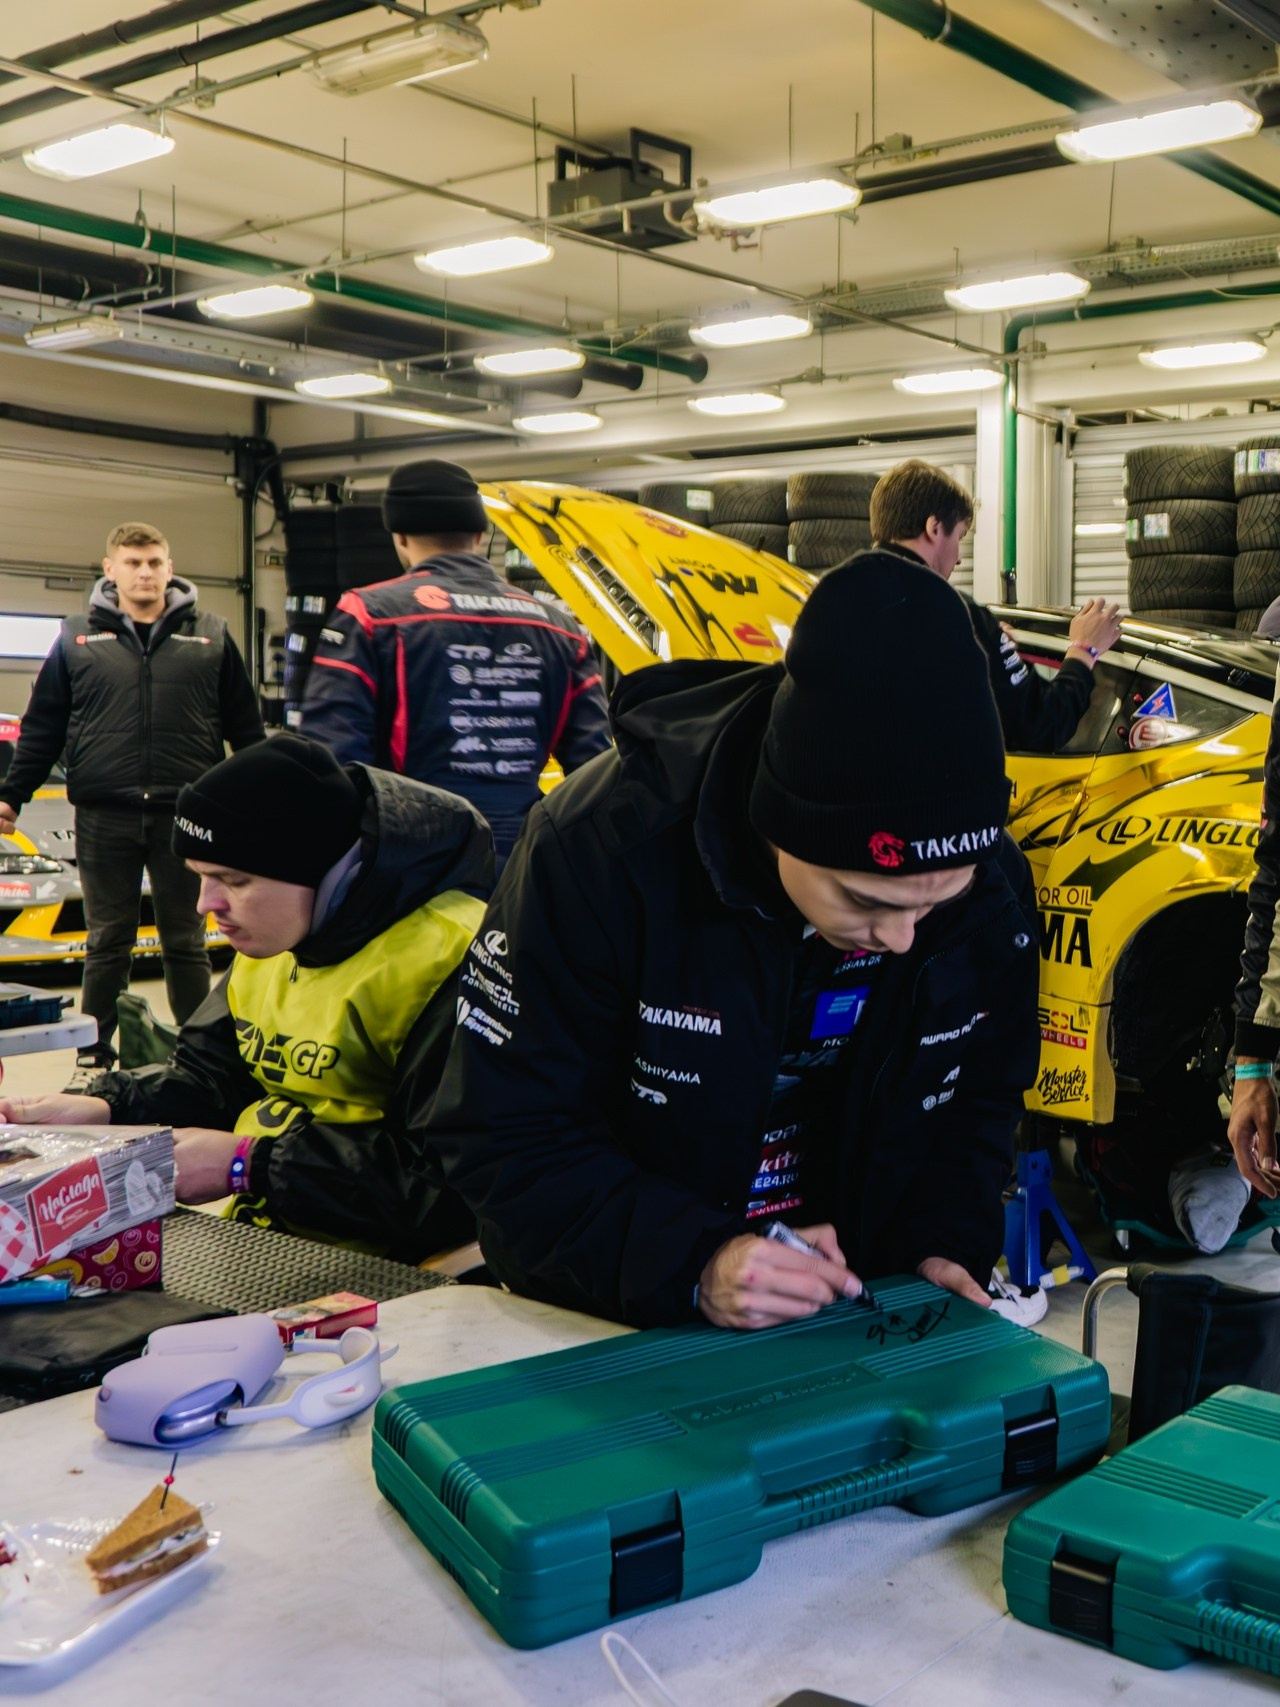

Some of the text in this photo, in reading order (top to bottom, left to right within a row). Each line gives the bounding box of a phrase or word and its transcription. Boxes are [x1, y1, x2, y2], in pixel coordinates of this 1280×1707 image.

[910, 826, 999, 860] TAKAYAM
[1155, 818, 1259, 848] LINGLO
[1066, 889, 1092, 907] OIL
[470, 938, 513, 985] LINGLONG
[639, 1000, 722, 1036] TAKAYAMA
[290, 1040, 342, 1080] GP
[635, 1057, 701, 1084] ASHIYAMA
